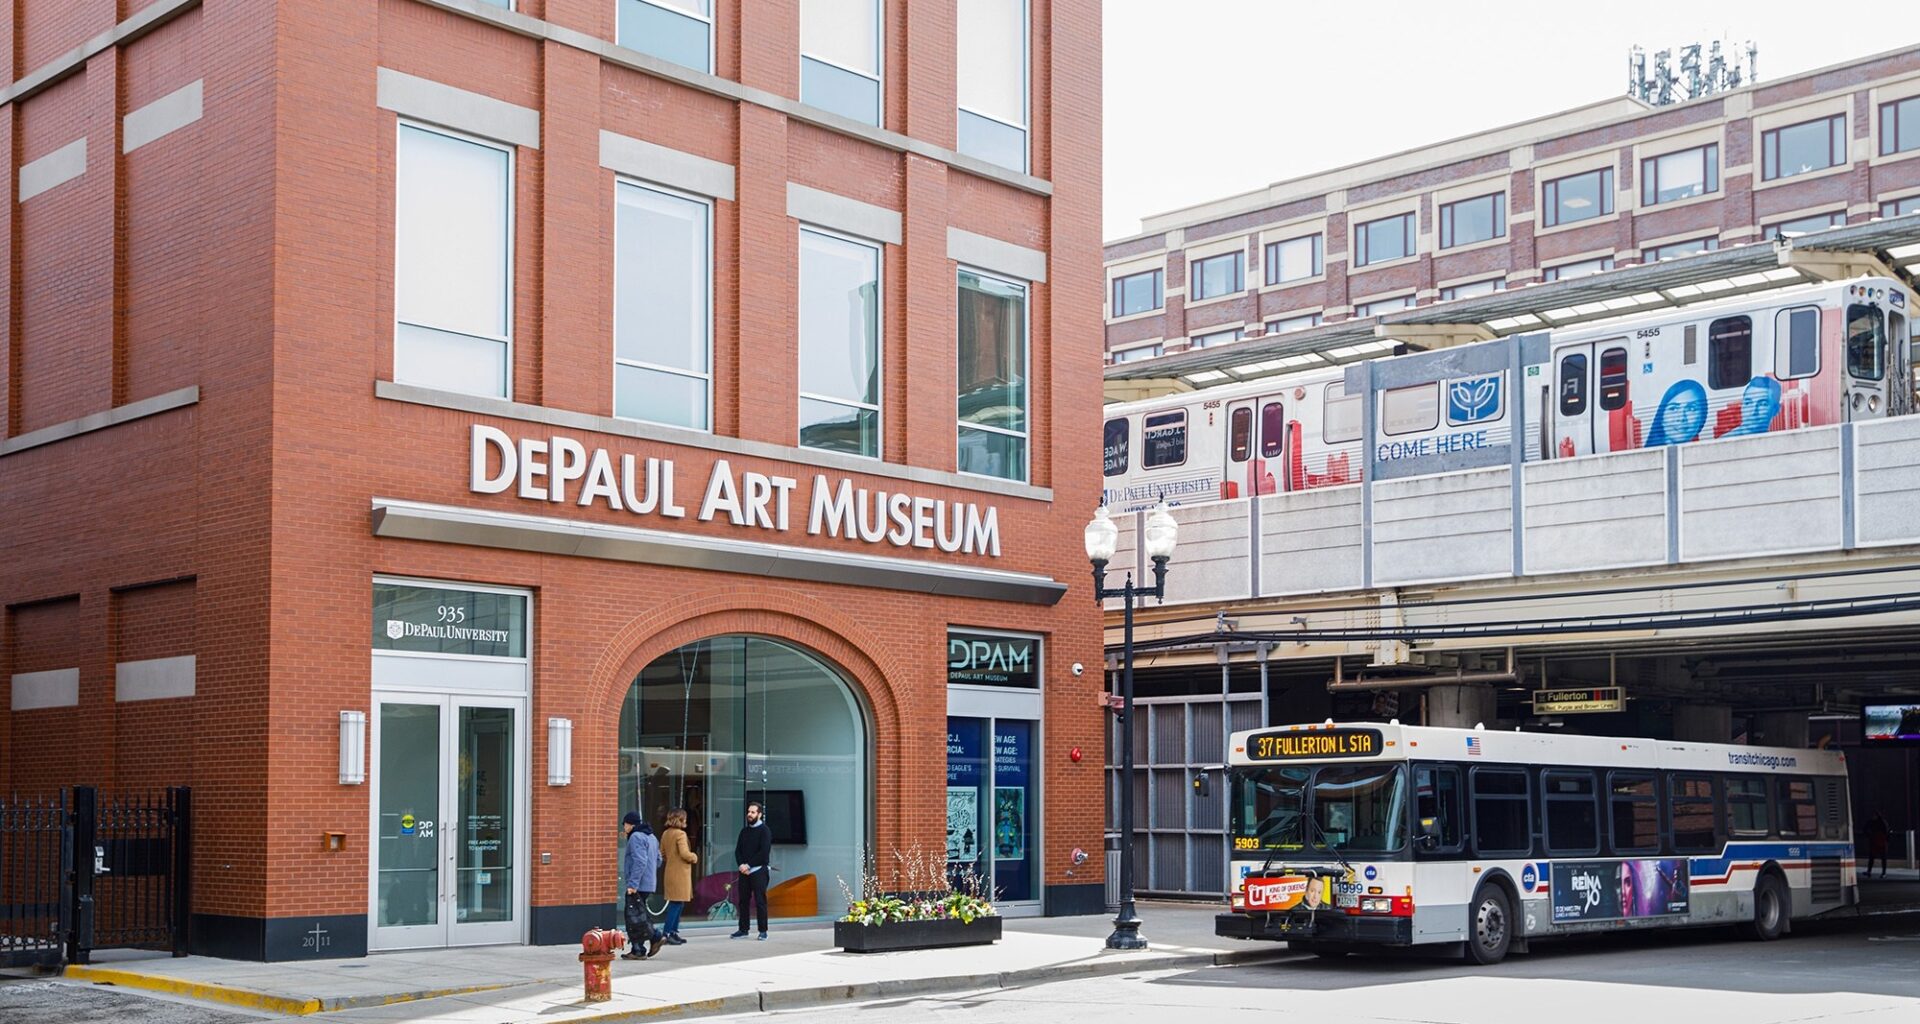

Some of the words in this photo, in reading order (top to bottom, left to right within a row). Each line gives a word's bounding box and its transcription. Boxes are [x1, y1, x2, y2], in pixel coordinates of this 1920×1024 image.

[1637, 327, 1660, 339] 5455
[1203, 402, 1220, 410] 5455
[1378, 438, 1430, 461] COME
[1436, 430, 1492, 454] HERE.
[1148, 478, 1211, 497] UNIVERSITY
[698, 458, 797, 531] ART
[806, 473, 1001, 558] MUSEUM
[437, 605, 465, 624] 935
[446, 625, 509, 642] UNIVERSITY
[951, 639, 1028, 673] DPAM
[950, 671, 972, 680] DEPAUL
[985, 674, 1008, 682] MUSEUM
[1547, 692, 1588, 701] Fullerton
[1003, 735, 1017, 744] AGE
[1003, 746, 1018, 756] AGE:
[1258, 737, 1274, 757] 37
[1276, 736, 1337, 756] FULLERTON
[1339, 736, 1347, 753] L
[1350, 735, 1371, 752] STA
[1728, 752, 1797, 770] transitchicago.com
[419, 821, 433, 829] DP
[419, 830, 433, 838] AM
[1235, 838, 1259, 849] 5903
[1523, 873, 1535, 883] cta
[1338, 883, 1363, 894] 1999
